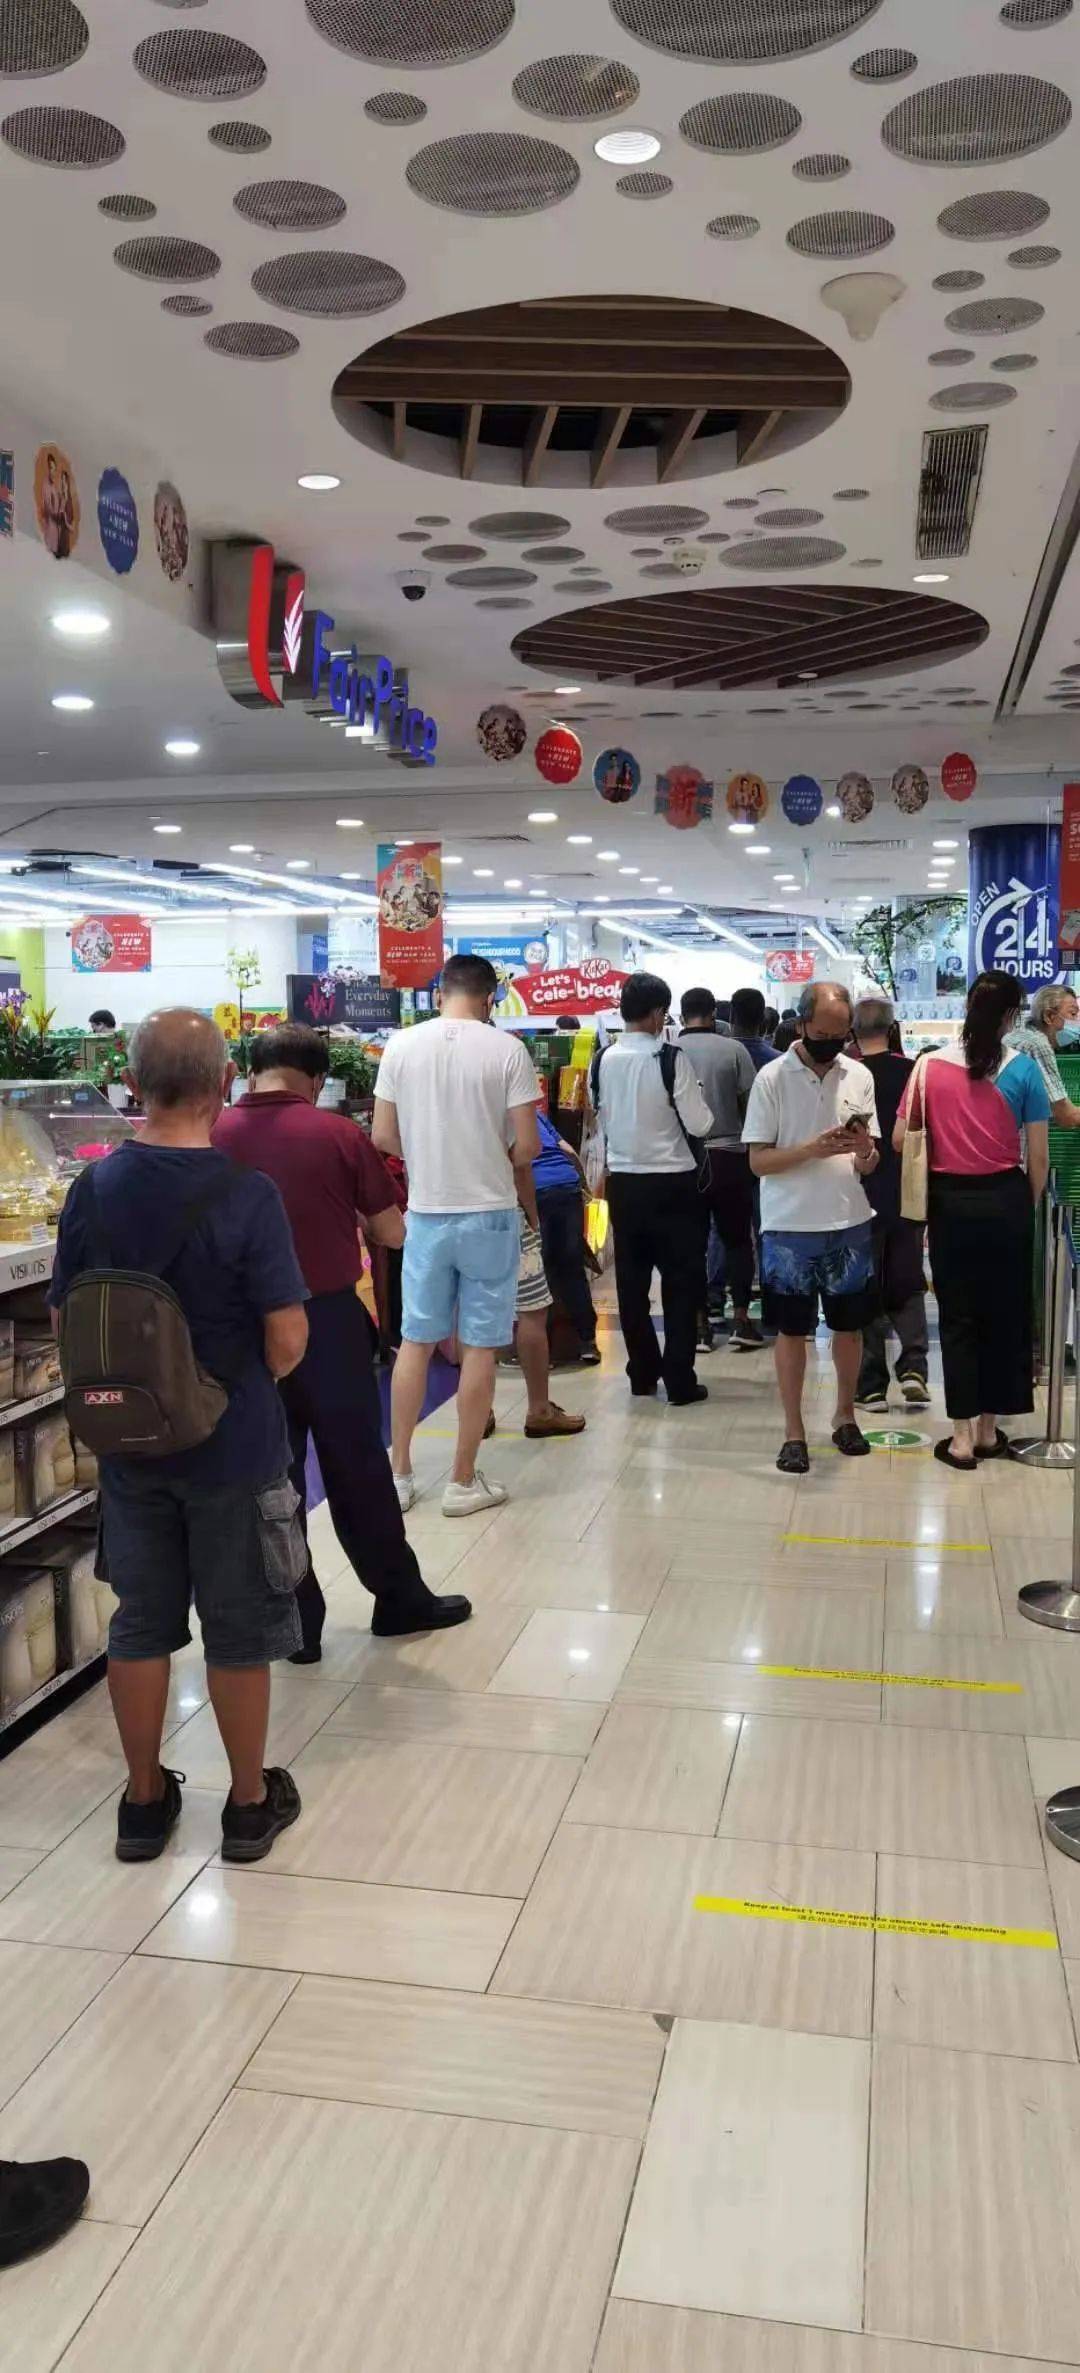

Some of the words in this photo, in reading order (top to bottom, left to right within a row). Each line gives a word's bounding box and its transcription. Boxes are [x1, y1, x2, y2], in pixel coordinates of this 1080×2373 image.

[312, 609, 437, 767] FairPrice
[971, 882, 1000, 927] OPEN
[121, 937, 141, 946] NEW
[994, 918, 1053, 959] 24
[583, 960, 608, 978] KitKat
[993, 959, 1054, 979] HOURS
[540, 973, 571, 987] Let's
[345, 990, 391, 1004] Everyday
[345, 1004, 391, 1017] Moments
[10, 1259, 47, 1280] VISINS
[87, 1392, 122, 1404] AXN
[744, 1901, 768, 1910] Keep
[781, 1905, 805, 1914] least
[816, 1911, 845, 1919] metre
[847, 1914, 875, 1923] apart
[889, 1918, 928, 1927] observe
[930, 1921, 951, 1929] safe
[953, 1924, 1007, 1936] distancing
